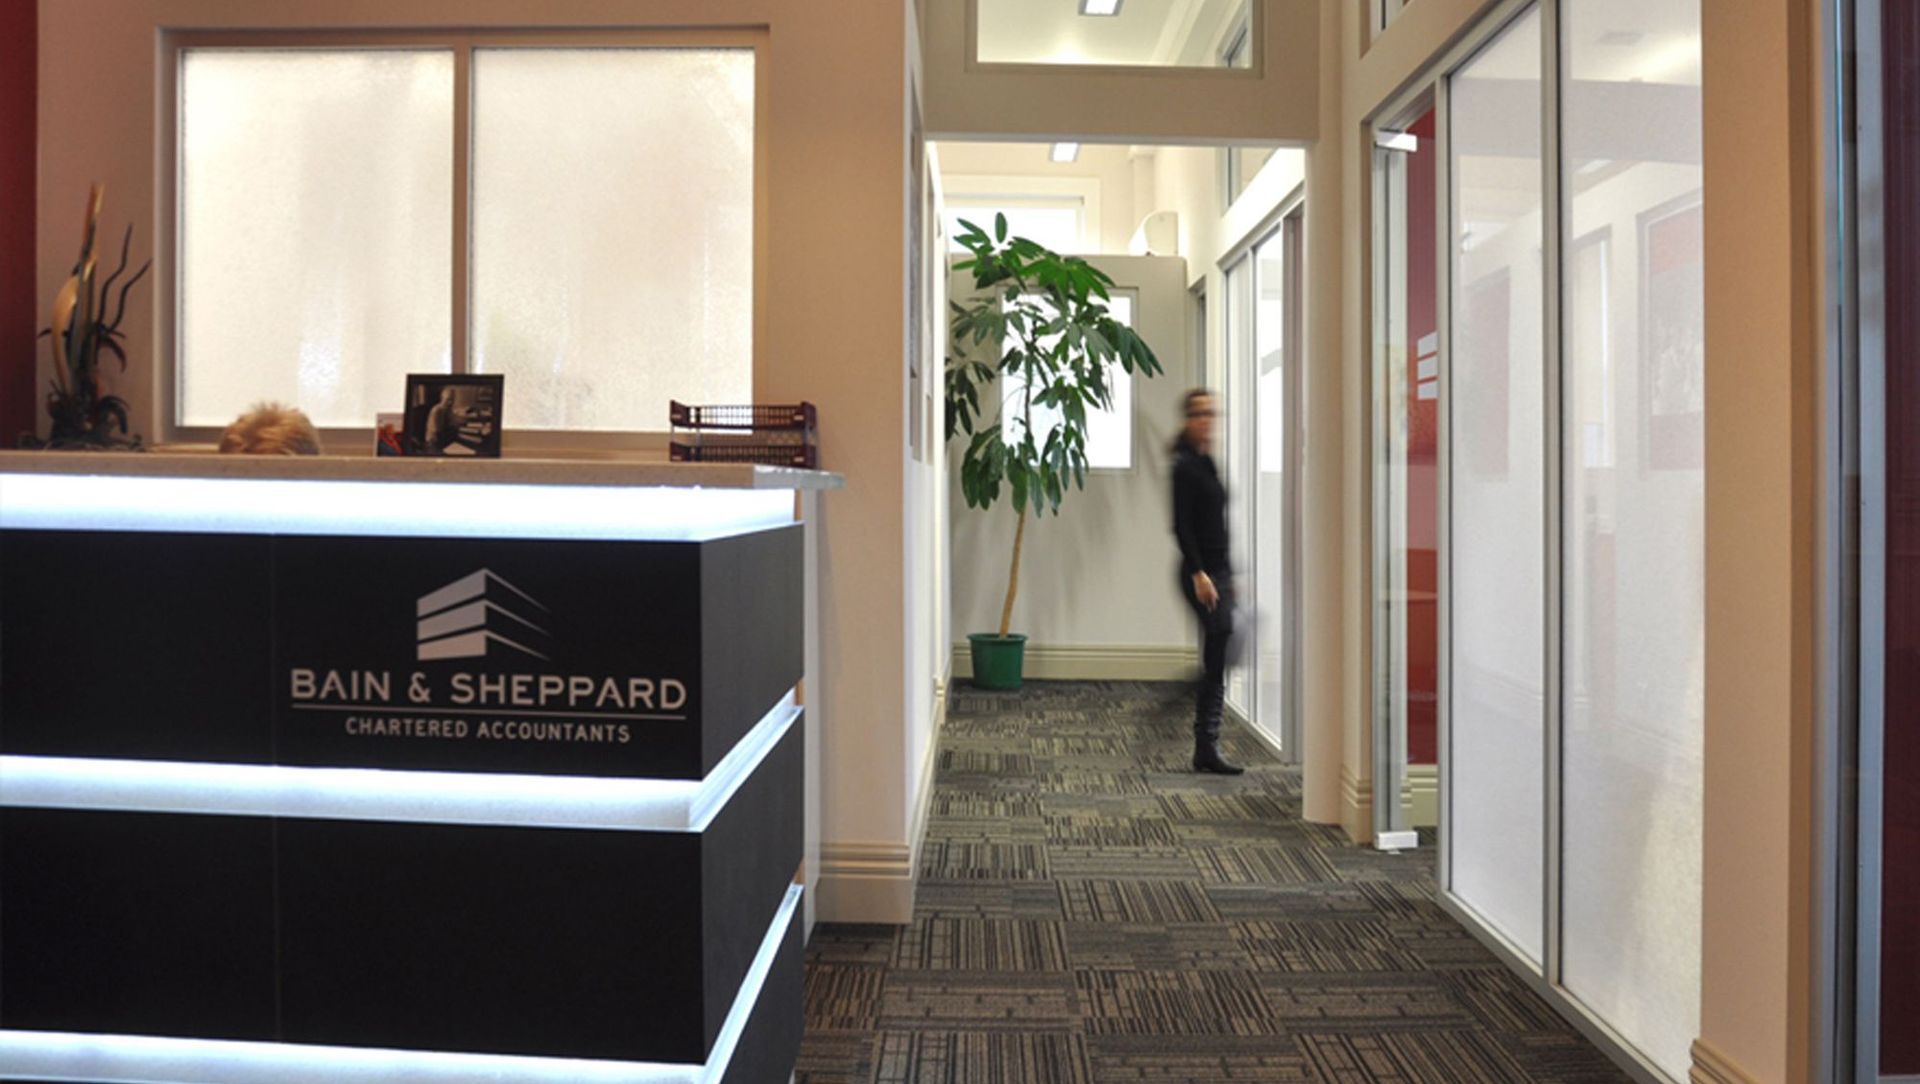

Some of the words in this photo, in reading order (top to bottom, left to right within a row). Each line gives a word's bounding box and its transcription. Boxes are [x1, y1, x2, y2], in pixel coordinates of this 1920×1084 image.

[291, 668, 391, 701] BAIN
[407, 671, 431, 703] &
[450, 672, 687, 710] SHEPPARD
[345, 716, 468, 739] CHARTERED
[476, 722, 631, 744] ACCOUNTANTS
